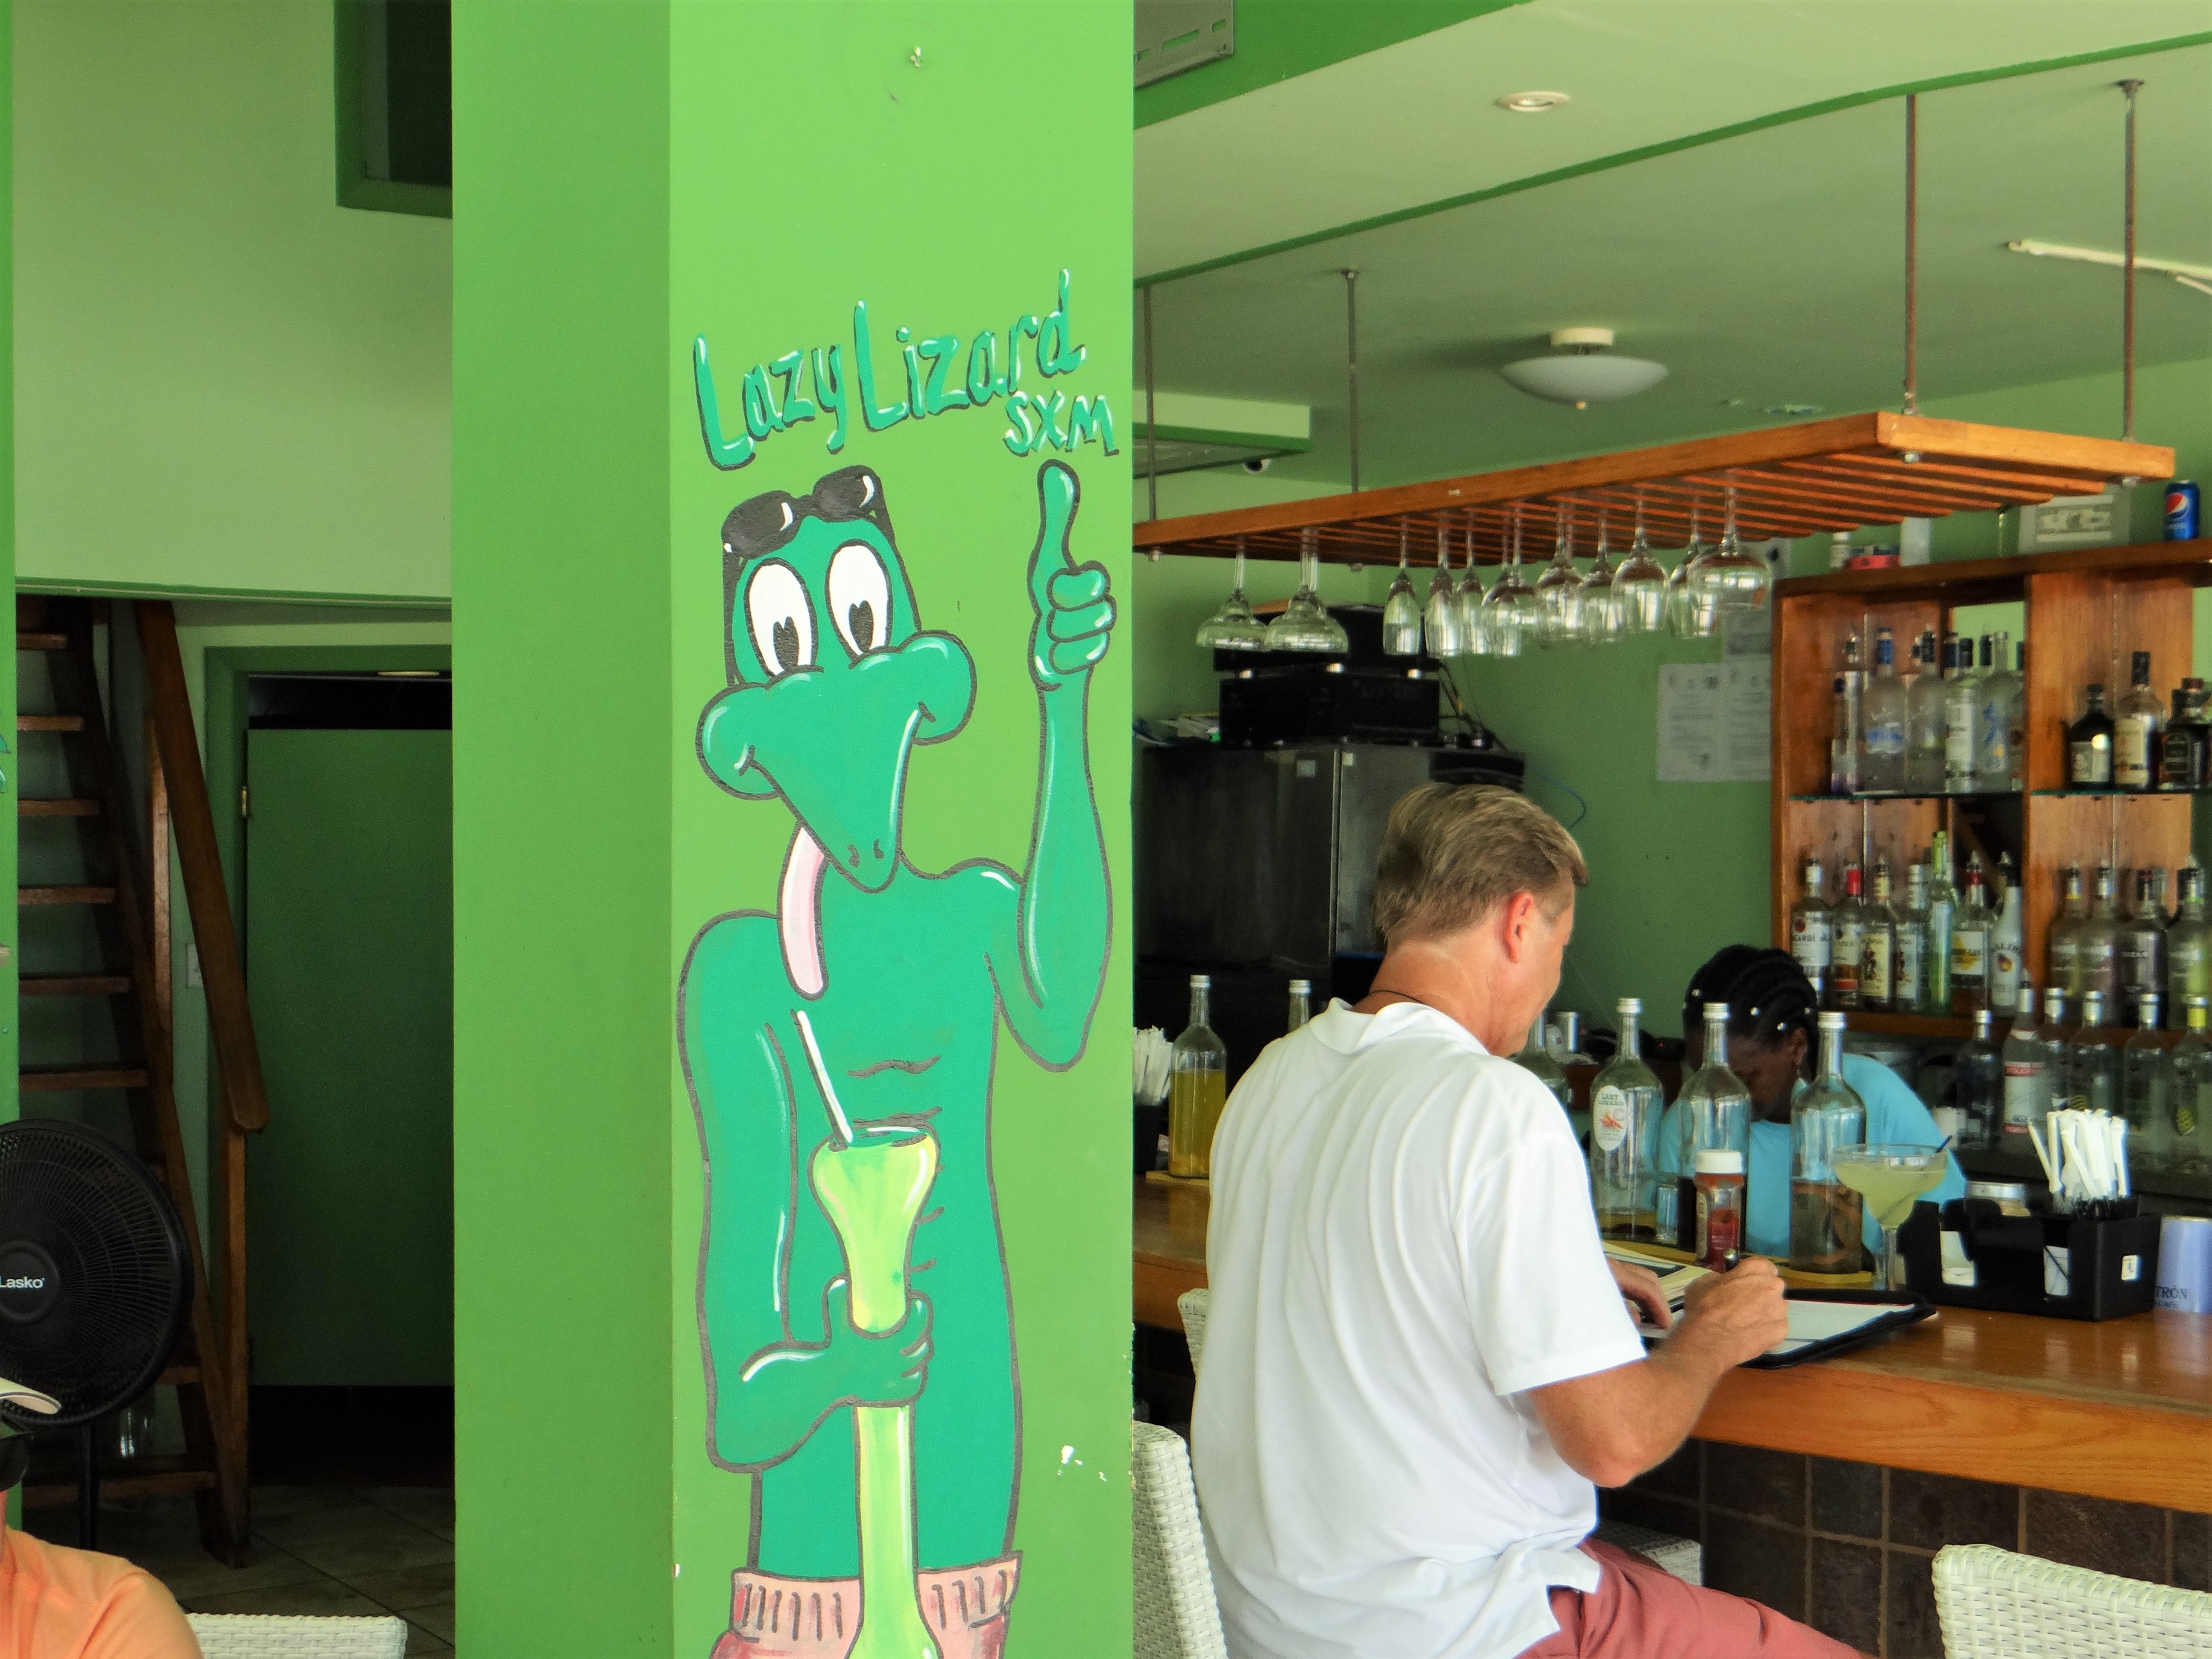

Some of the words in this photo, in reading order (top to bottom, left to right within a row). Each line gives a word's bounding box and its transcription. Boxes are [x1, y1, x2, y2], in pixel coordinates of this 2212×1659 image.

[693, 333, 847, 471] Lazy
[854, 269, 1086, 431] Lizard
[1003, 386, 1119, 457] SXM
[0, 1276, 43, 1288] Lasko
[2155, 1285, 2188, 1299] TRÓN
